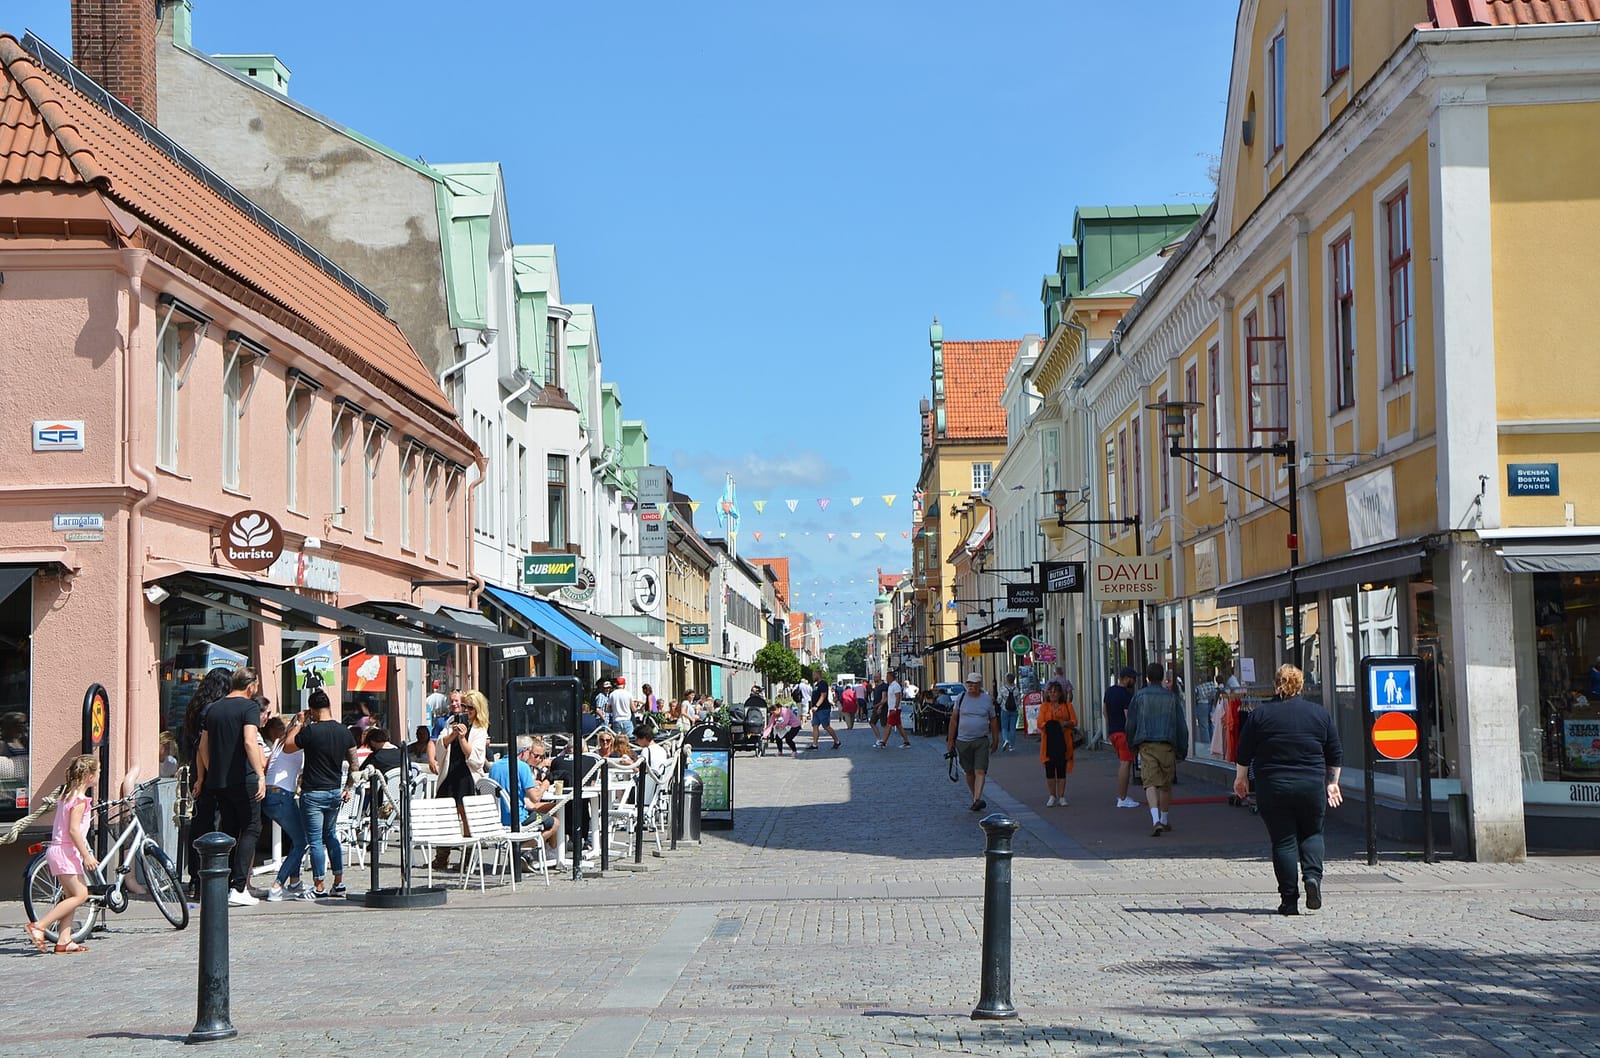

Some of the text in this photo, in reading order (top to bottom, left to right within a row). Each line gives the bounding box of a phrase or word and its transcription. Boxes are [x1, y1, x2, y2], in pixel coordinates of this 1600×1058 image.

[229, 547, 274, 559] barista
[526, 562, 575, 575] SUBWAY
[1097, 563, 1159, 581] DAYLI
[682, 626, 705, 635] SEB
